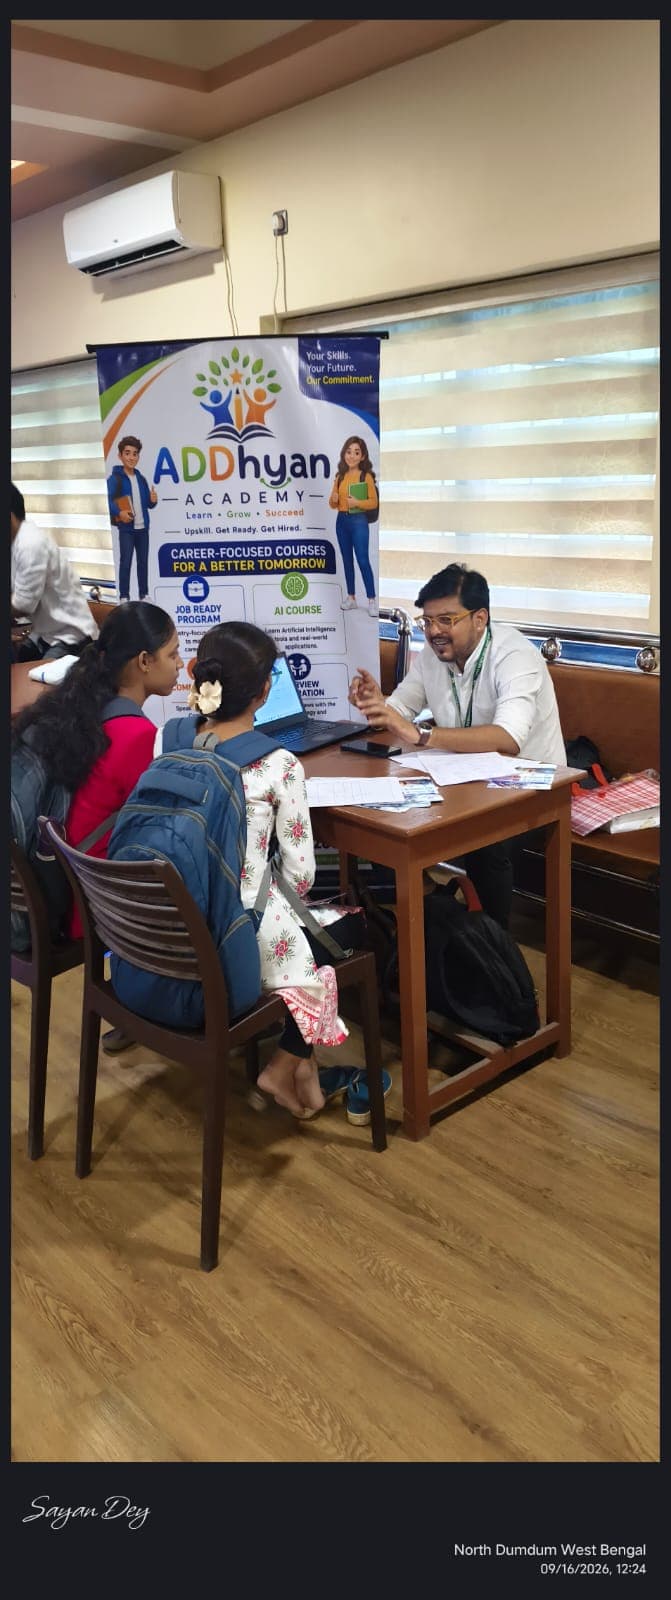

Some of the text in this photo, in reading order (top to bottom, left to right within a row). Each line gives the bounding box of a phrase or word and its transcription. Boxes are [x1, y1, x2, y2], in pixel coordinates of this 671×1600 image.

[306, 351, 351, 361] Your Skills.
[306, 363, 357, 373] Your Future.
[306, 374, 375, 385] Our Commitment.
[153, 445, 331, 487] ADDhyan
[185, 490, 305, 506] ACADEMY
[186, 508, 304, 520] Learn Grow Succeed
[184, 527, 213, 536] Upskill.
[232, 526, 257, 536] Ready.
[261, 525, 276, 534] Get
[278, 524, 302, 533] Hired.
[170, 545, 327, 560] CAREER-FOCUSED COURSES
[173, 558, 326, 573] FOR A BETTER TOMORROW
[175, 604, 222, 614] JOB READY
[274, 605, 322, 615] AI COURSE
[177, 615, 221, 624] PROGRAM
